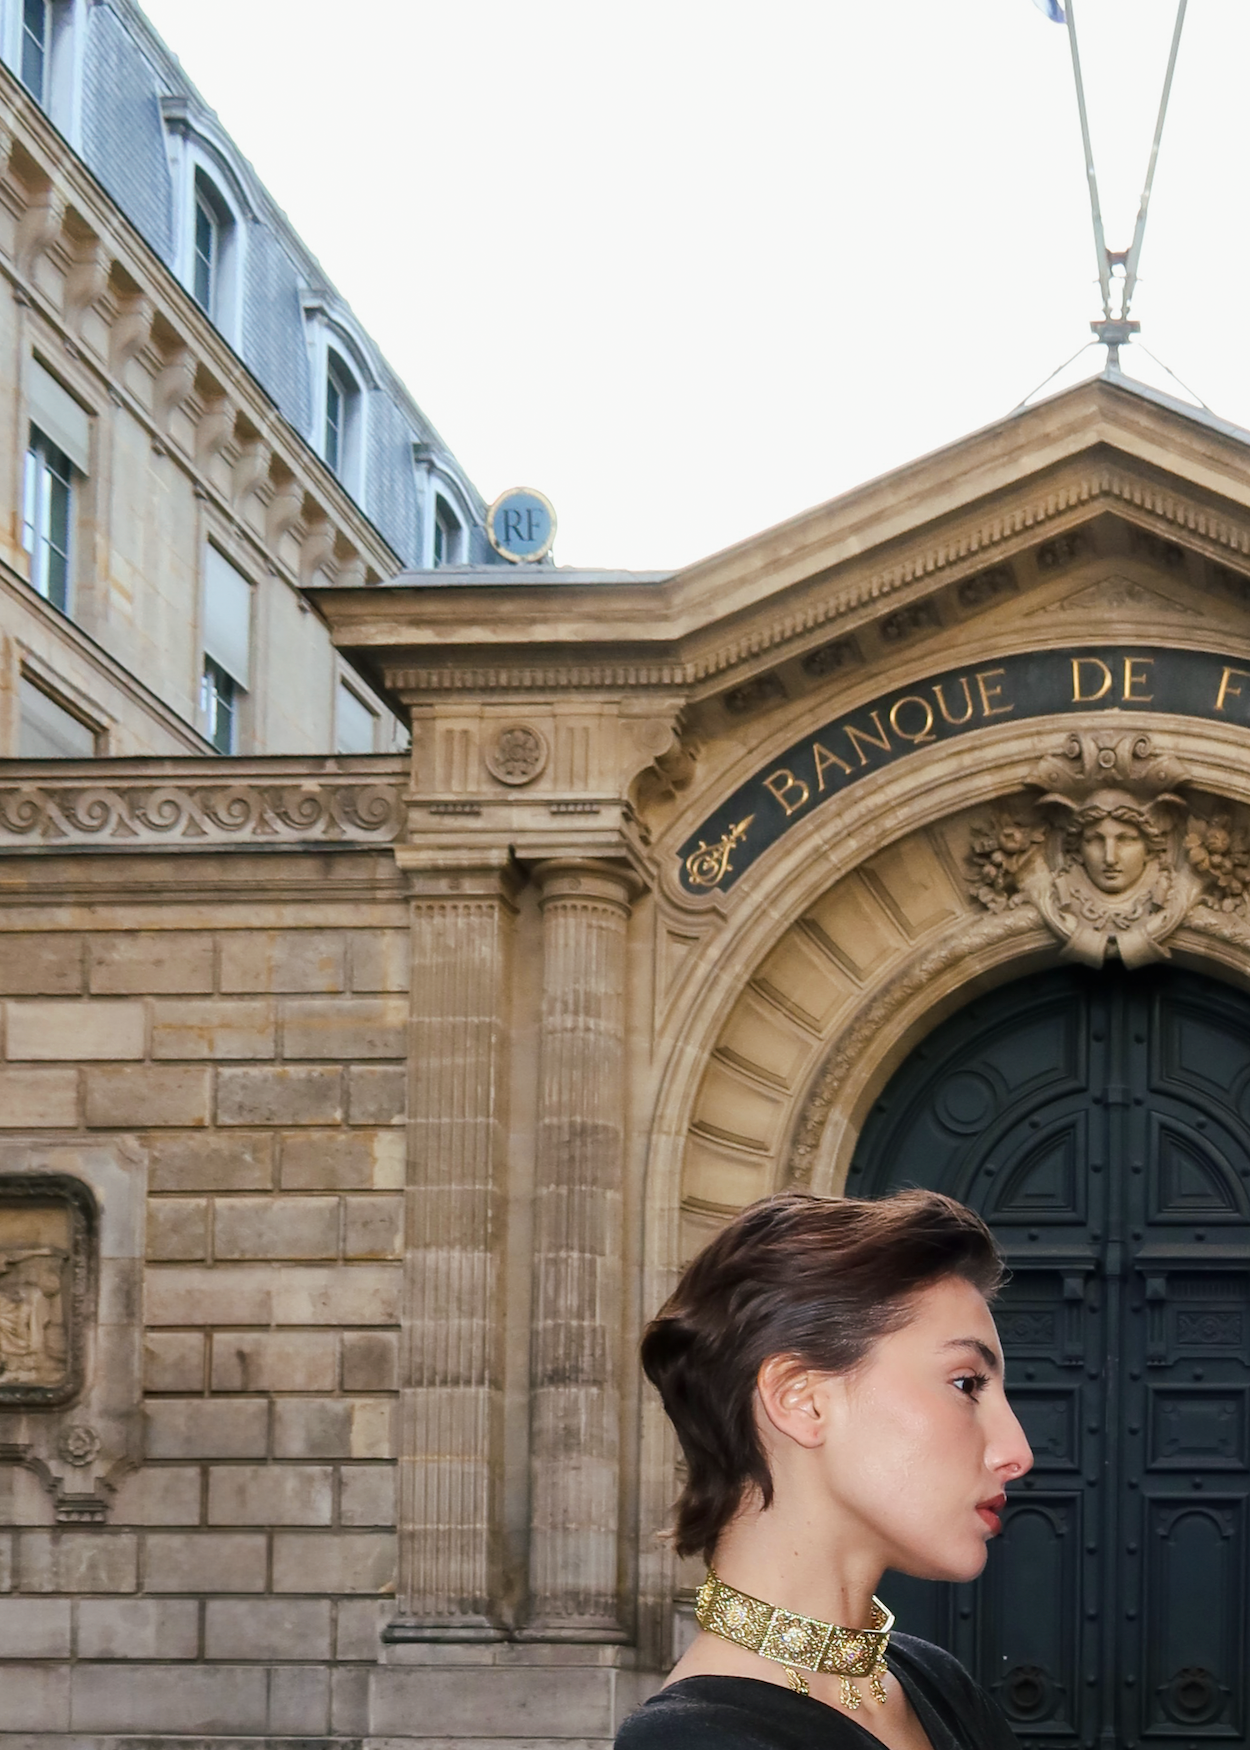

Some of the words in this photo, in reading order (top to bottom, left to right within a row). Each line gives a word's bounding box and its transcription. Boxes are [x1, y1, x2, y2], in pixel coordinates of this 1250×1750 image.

[503, 508, 544, 542] RF
[762, 669, 1014, 816] BANQUE
[1071, 657, 1155, 703] DE
